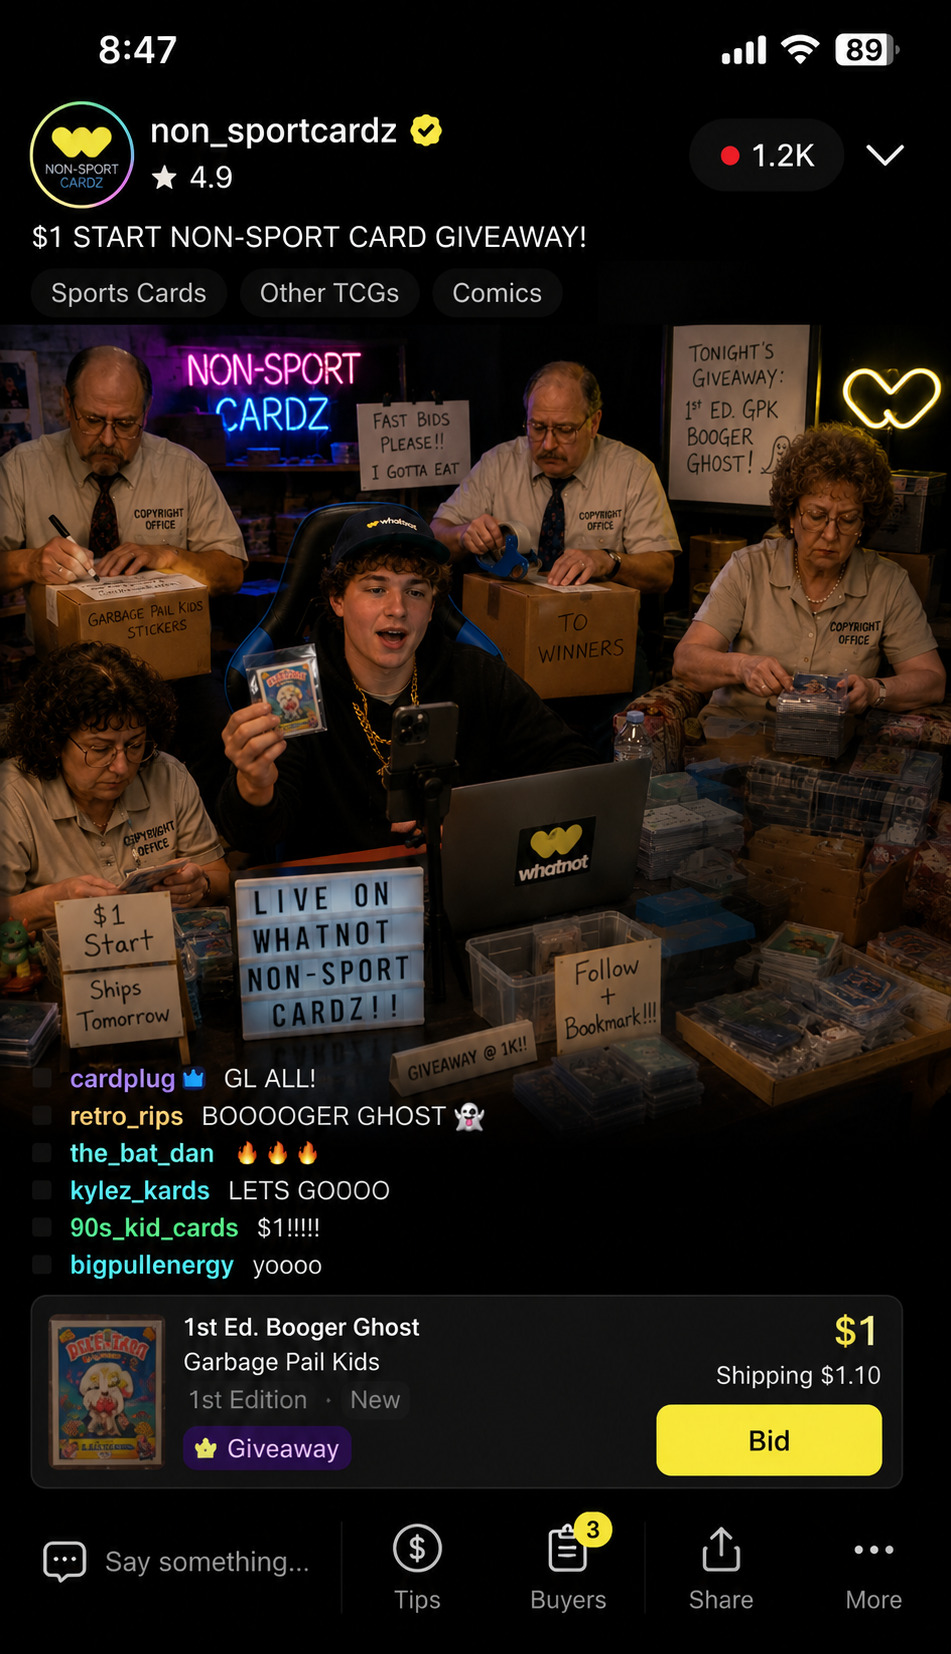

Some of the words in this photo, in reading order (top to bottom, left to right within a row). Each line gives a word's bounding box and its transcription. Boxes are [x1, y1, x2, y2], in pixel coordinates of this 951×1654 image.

[688, 341, 774, 362] TONIGHT'S
[186, 351, 362, 386] NON-SPORT
[692, 368, 784, 389] GIVEAWAY:
[215, 397, 330, 432] CARDZ
[373, 411, 408, 430] FAST
[416, 412, 451, 428] BIDS
[685, 400, 702, 420] 1st
[710, 401, 735, 419] ED.
[742, 399, 778, 421] GPK
[380, 433, 445, 453] PLEASE!!
[687, 426, 754, 447] BOOGER
[371, 465, 379, 481] I
[386, 463, 428, 479] GOTTA
[434, 462, 460, 476] EAT
[686, 450, 753, 475] GHOST!
[134, 508, 184, 519] COPYRIGHT
[145, 520, 176, 530] OFFICE
[579, 509, 622, 521] COPYRIGHT
[587, 520, 614, 531] OFFICE
[88, 608, 144, 627] GARBAGE
[150, 604, 175, 618] PAIL
[178, 600, 204, 614] KIDS
[558, 612, 588, 632] TO
[127, 619, 188, 639] STICKERS
[830, 620, 881, 632] COPYRIGHT
[538, 638, 625, 664] WINNERS
[838, 634, 870, 645] OFFICE
[518, 854, 589, 882] whatnot
[254, 886, 328, 915] LIVE
[355, 881, 389, 907] ON
[93, 903, 126, 927] $1
[84, 929, 154, 957] Start
[253, 919, 390, 954] WHATNOT
[248, 955, 410, 992] NON-SPORT
[575, 957, 640, 986] Follow
[90, 979, 142, 1004] Ships
[601, 987, 616, 1005] +
[76, 1008, 170, 1032] Tomorrow
[272, 994, 399, 1028] CARDZ!!
[564, 1001, 657, 1040] Bookmark!!!
[407, 1049, 477, 1081] GIVEAWAY
[483, 1045, 497, 1061] @
[501, 1036, 527, 1056] 1K!!
